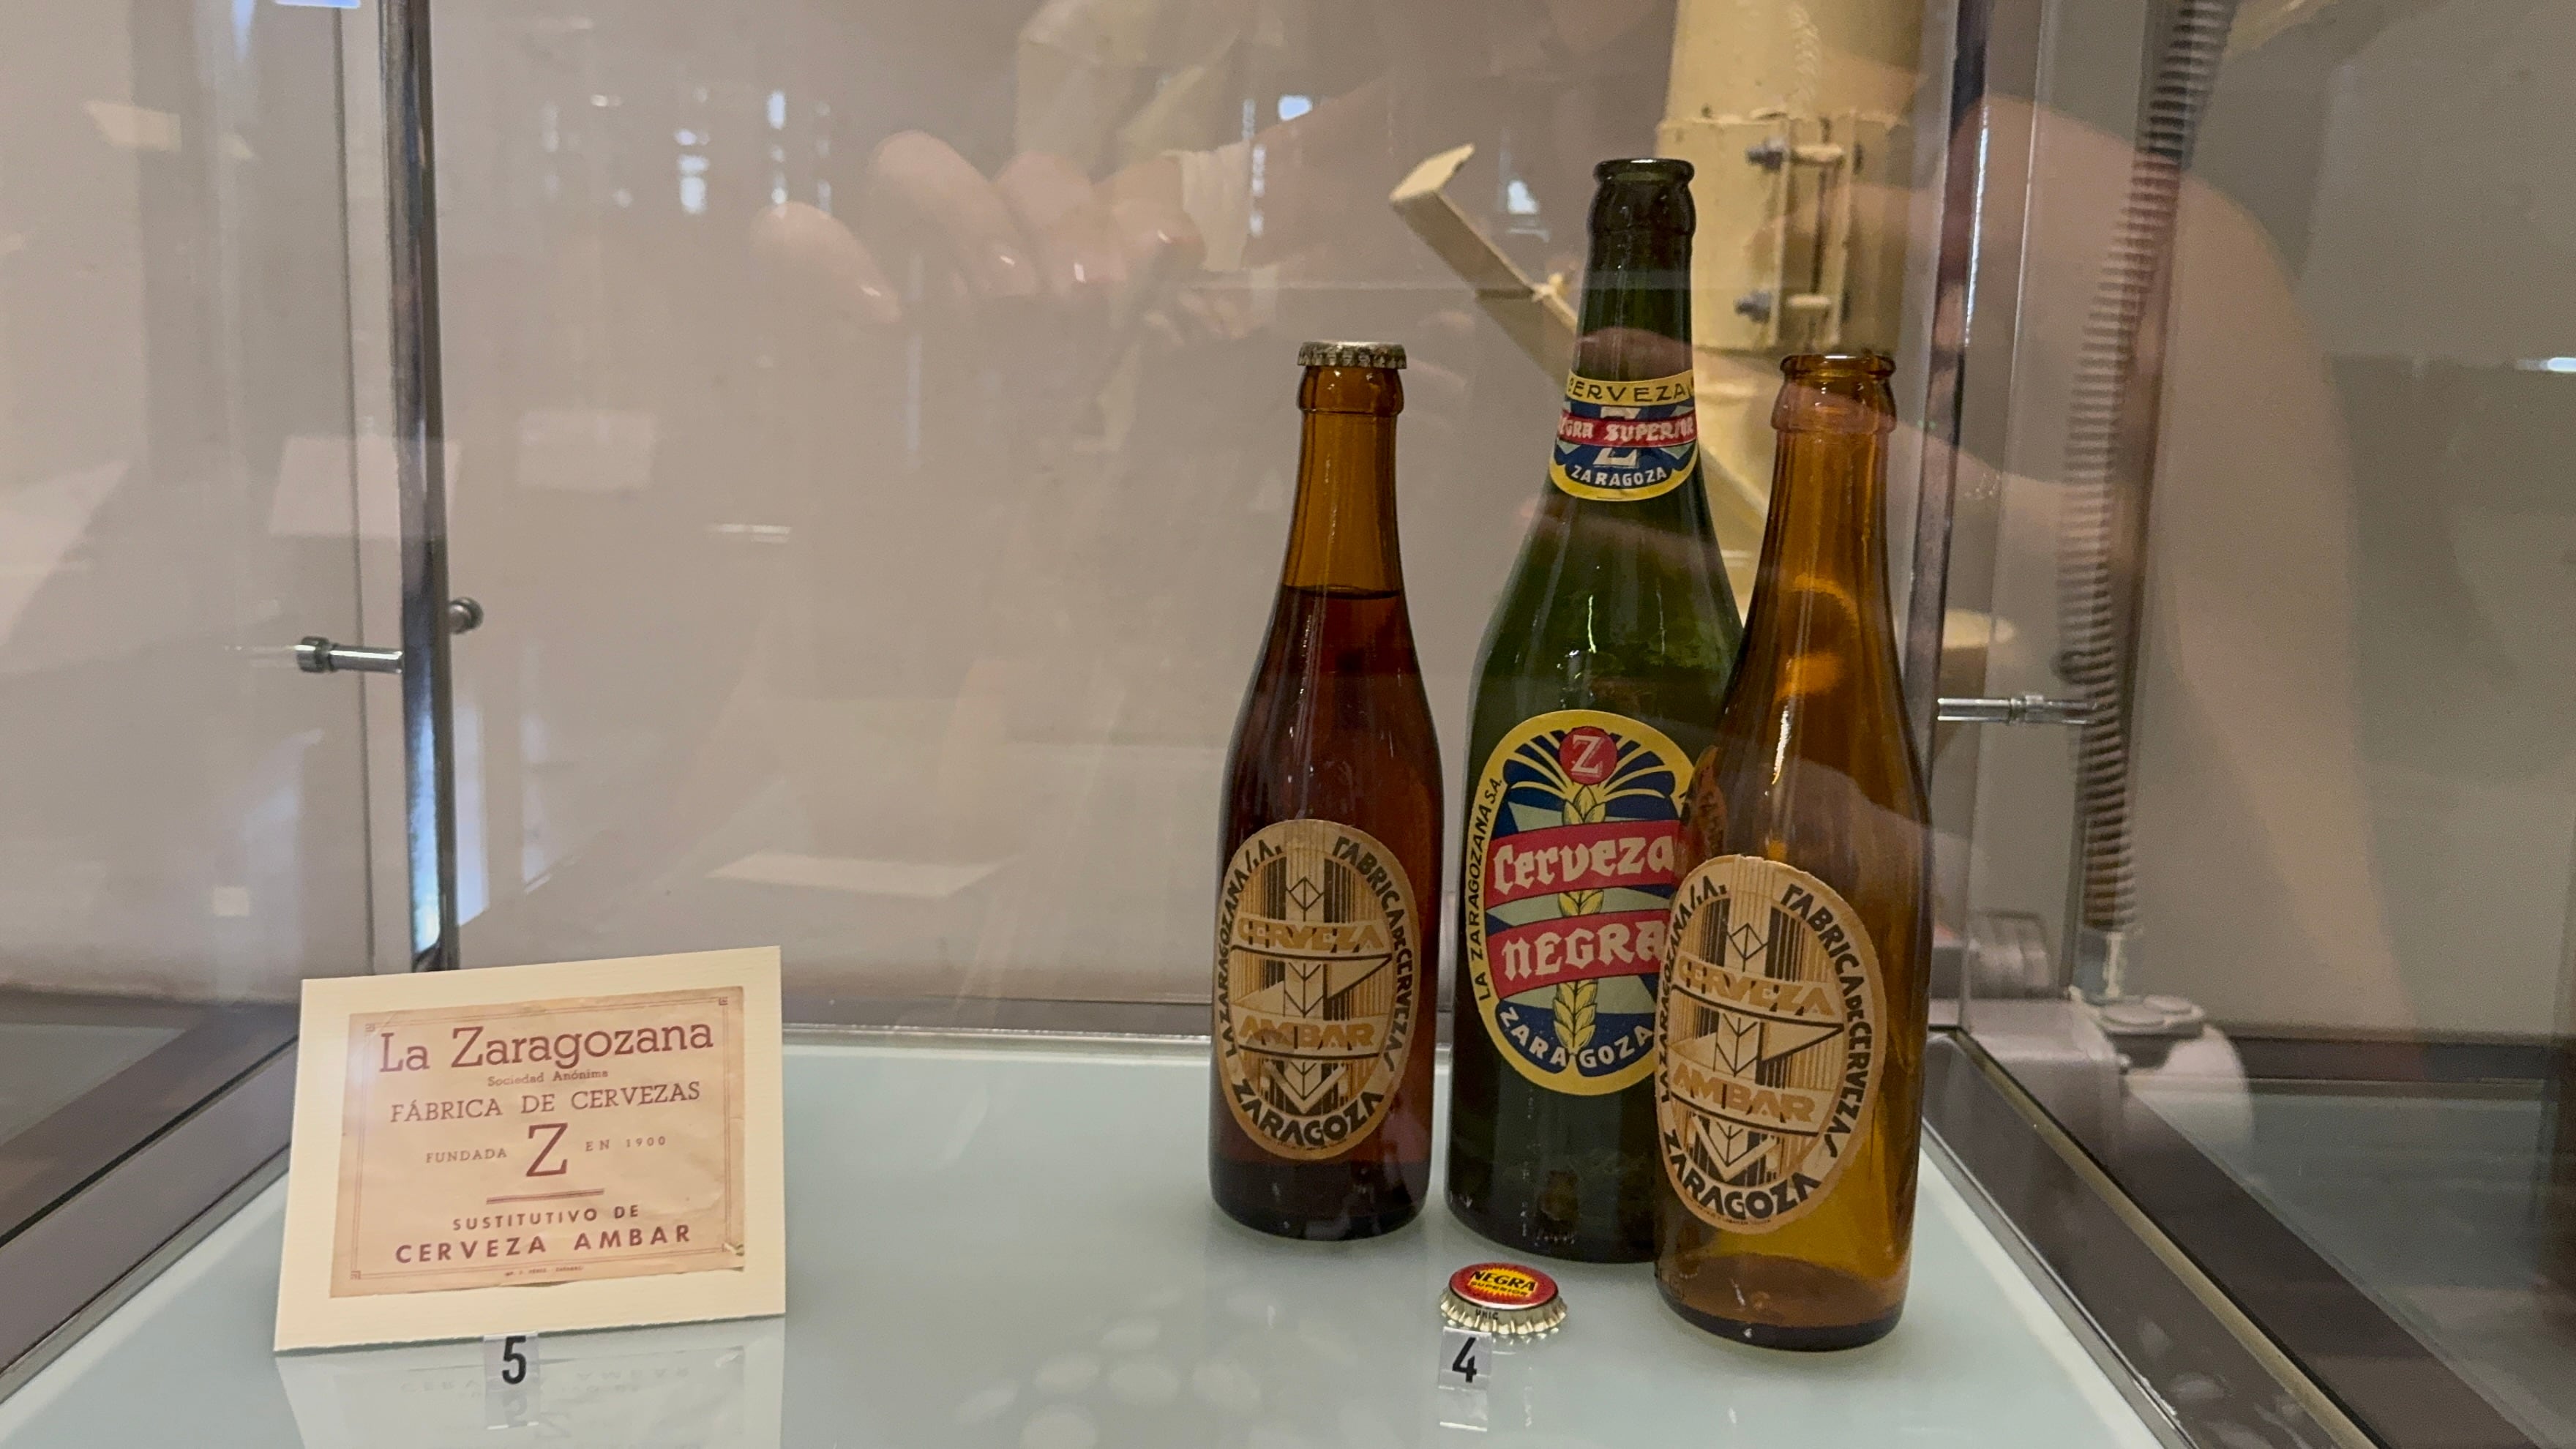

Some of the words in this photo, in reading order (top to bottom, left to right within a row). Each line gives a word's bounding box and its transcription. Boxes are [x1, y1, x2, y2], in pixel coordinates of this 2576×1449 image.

[1558, 416, 1594, 439] GRA
[1570, 465, 1667, 486] ZARAGOZA
[1571, 734, 1603, 777] Z
[1485, 777, 1502, 805] S.A.
[1332, 836, 1404, 929] FABRICA
[1468, 804, 1491, 962] ZARAGOZANA
[1493, 836, 1675, 895] Cerveza
[1238, 918, 1385, 953] CERVEZA
[1502, 920, 1666, 981] NEGRA
[1781, 883, 1865, 996] FABRICA
[1475, 971, 1490, 1002] LA
[1677, 960, 1835, 1016] CERVEZA
[379, 1032, 430, 1073] La
[451, 1022, 714, 1069] Zaragozana
[1238, 1015, 1375, 1051] AMBAR
[1499, 1006, 1653, 1068] ZARAGOZA
[487, 1072, 544, 1088] Sociedad
[552, 1067, 609, 1082] Anónima
[1673, 1063, 1815, 1123] AMBAR
[390, 1098, 503, 1123] FÁBRICA
[520, 1093, 555, 1114] DE
[570, 1082, 700, 1111] CERVEZAS
[1232, 1078, 1385, 1147] ZARAGOZA
[426, 1147, 507, 1164] FUNDADA
[585, 1139, 610, 1152] EN
[626, 1135, 667, 1149] 1900
[525, 1123, 569, 1177] Z
[1665, 1129, 1821, 1219] ZARAGOZA
[452, 1208, 597, 1231] SUSTITUTIVO
[614, 1205, 639, 1219] DE
[395, 1235, 547, 1264] CERVEZA
[574, 1224, 690, 1251] AMBAR
[1469, 1270, 1536, 1292] NEGRA
[1470, 1281, 1528, 1295] SUPERIOR
[501, 1336, 528, 1385] 5
[1452, 1336, 1477, 1383] 4
